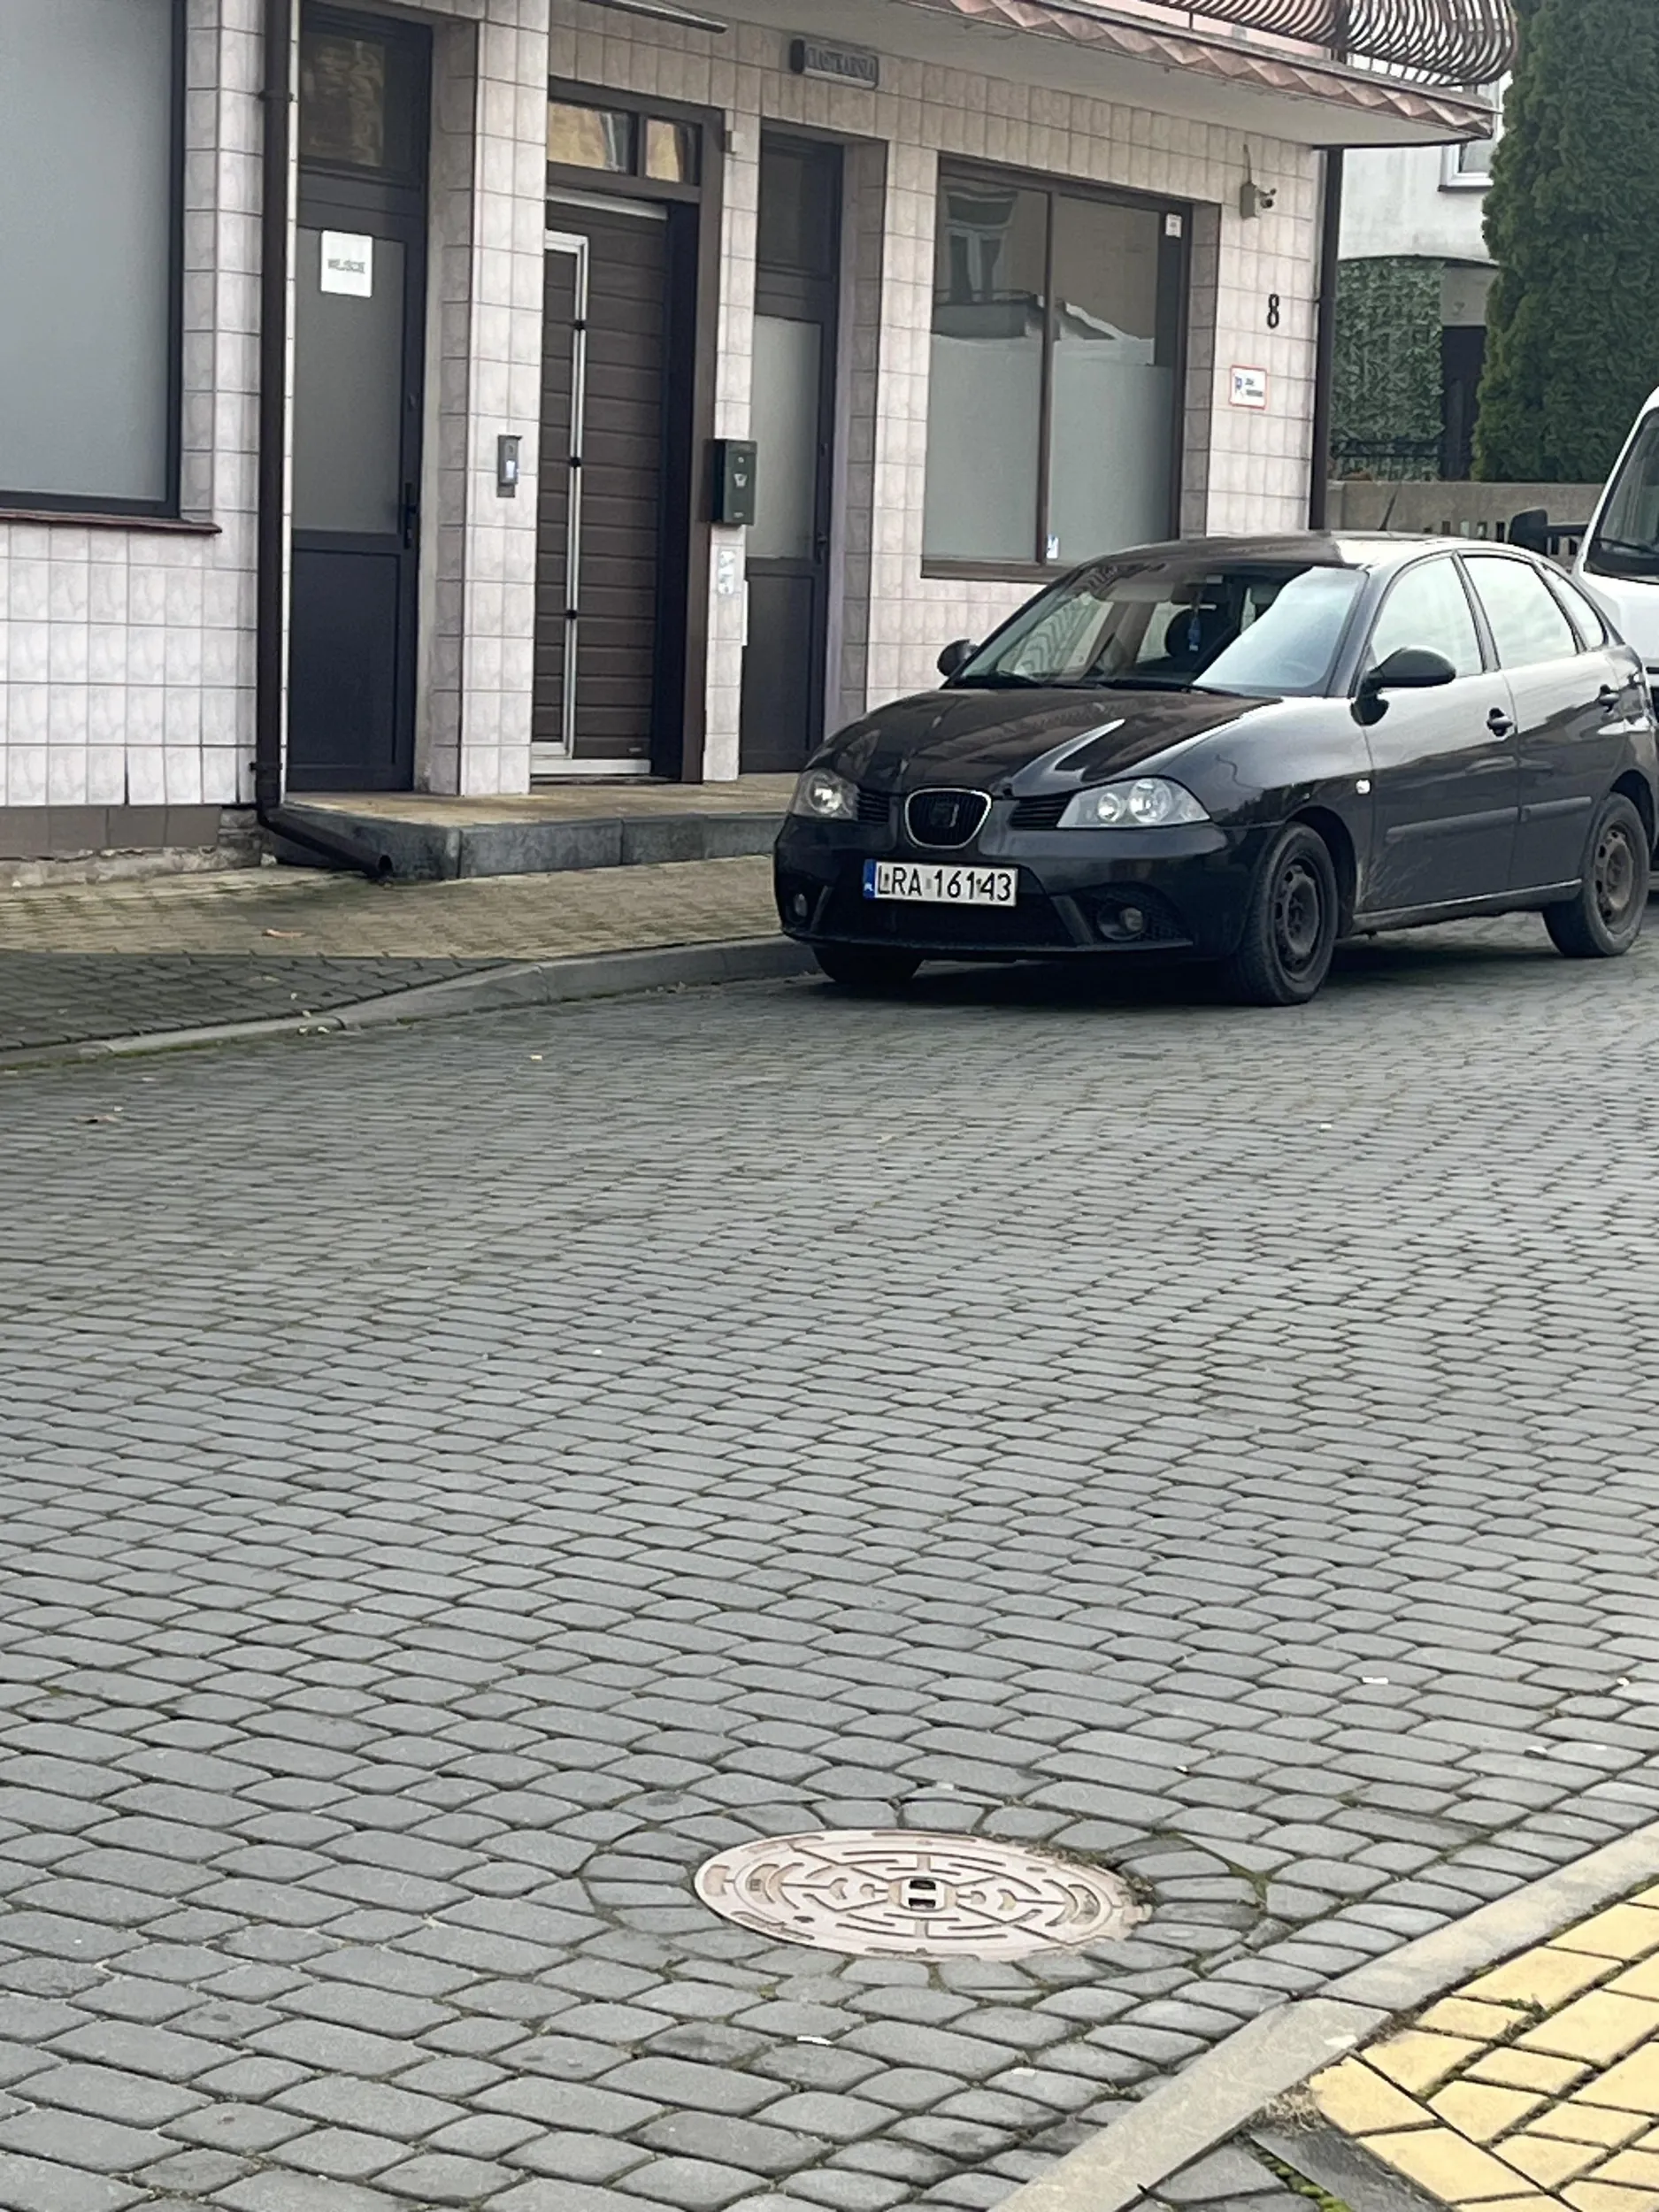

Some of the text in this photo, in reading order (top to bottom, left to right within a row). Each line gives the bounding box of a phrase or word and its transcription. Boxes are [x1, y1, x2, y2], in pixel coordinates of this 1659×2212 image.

[1267, 293, 1279, 329] 8
[878, 865, 1012, 901] LRA 16143
